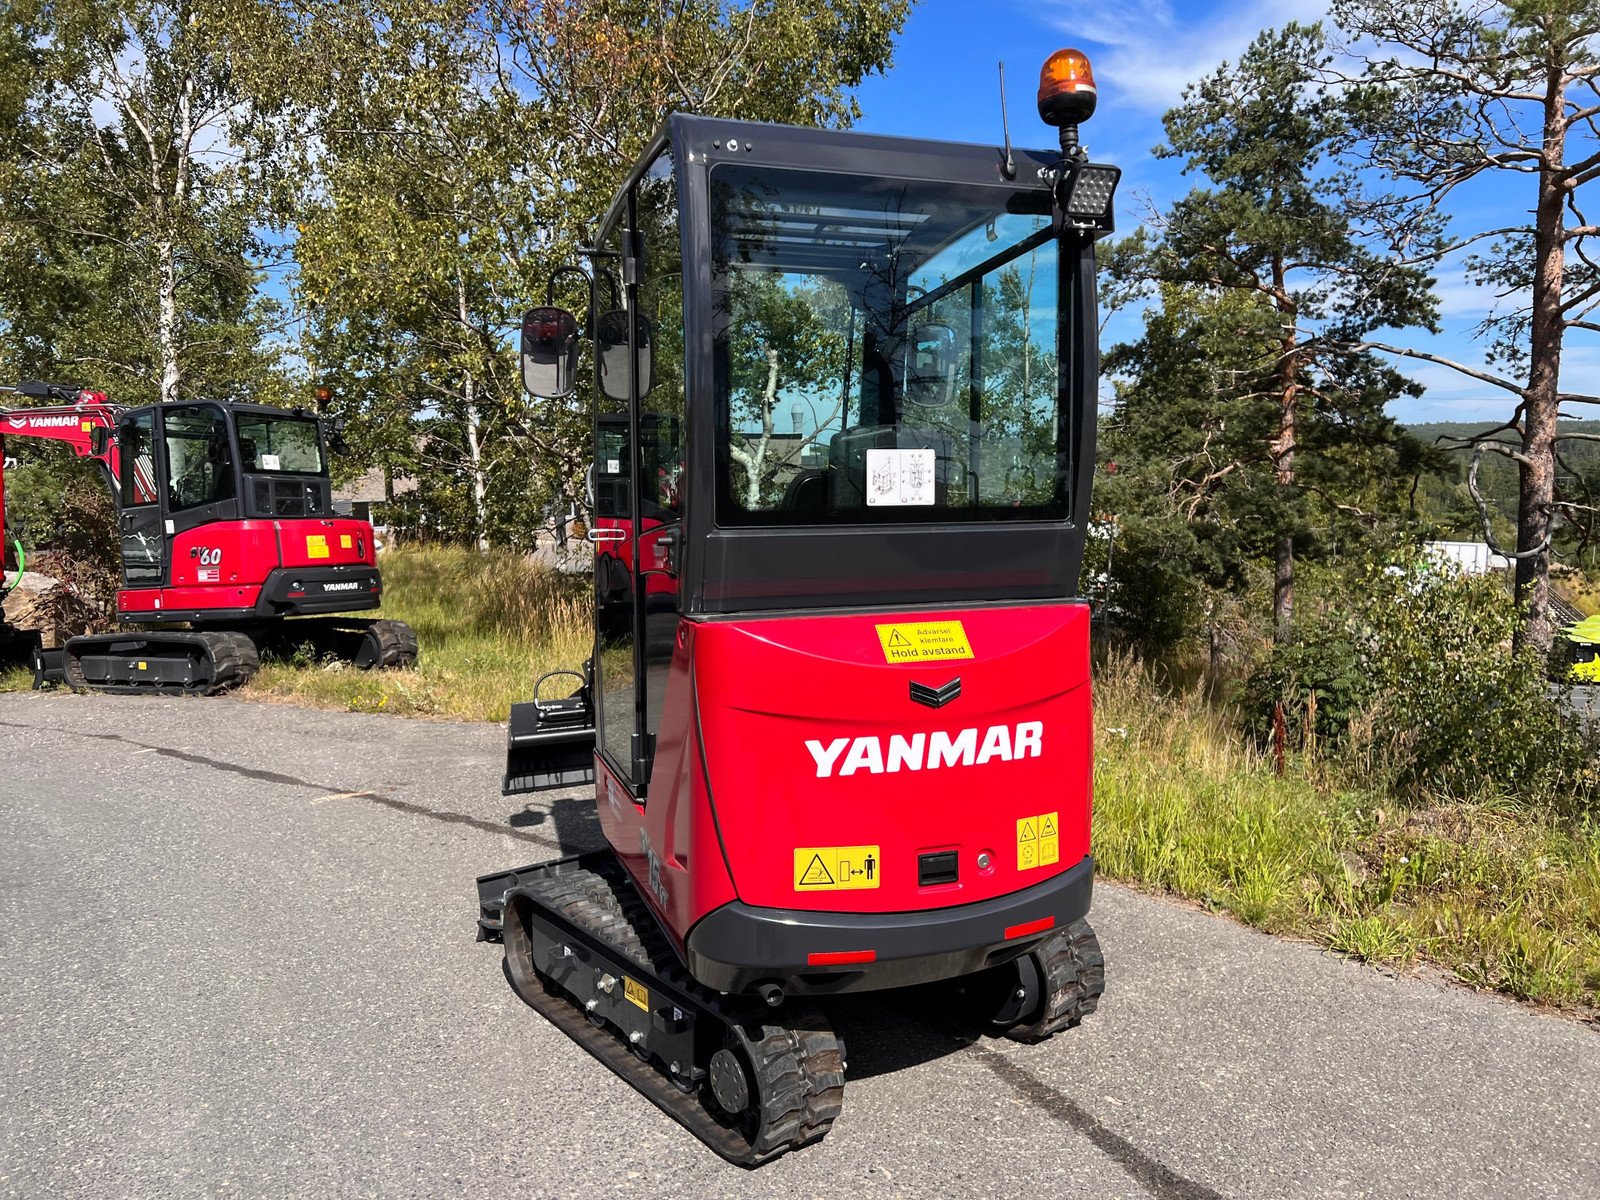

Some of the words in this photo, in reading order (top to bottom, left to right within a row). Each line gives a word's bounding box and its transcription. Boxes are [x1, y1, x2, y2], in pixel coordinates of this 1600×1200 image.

[29, 416, 79, 427] YANMAR
[323, 582, 358, 592] YANMAR
[891, 648, 919, 658] Hold
[922, 646, 966, 656] avstand
[804, 720, 1043, 778] YANMAR
